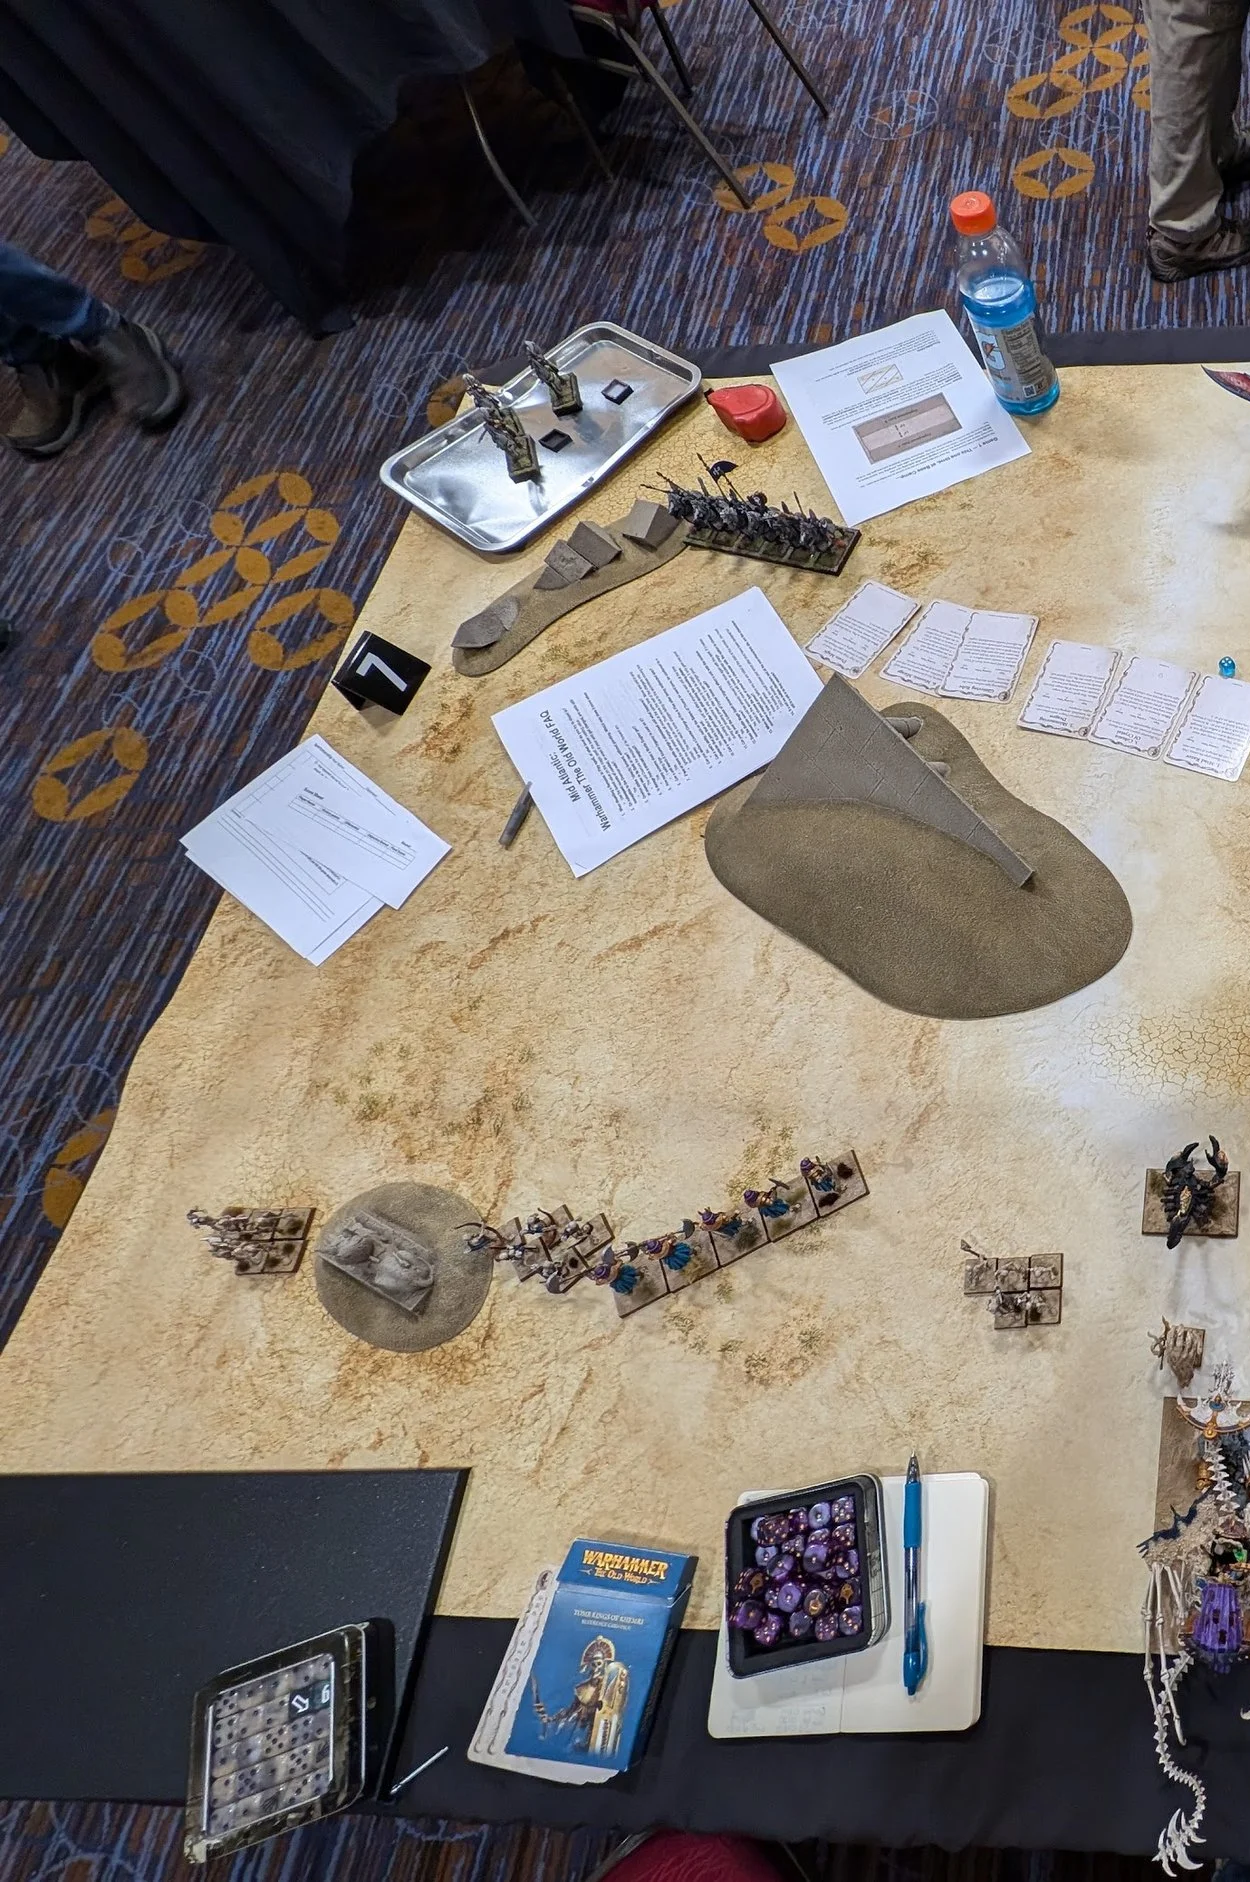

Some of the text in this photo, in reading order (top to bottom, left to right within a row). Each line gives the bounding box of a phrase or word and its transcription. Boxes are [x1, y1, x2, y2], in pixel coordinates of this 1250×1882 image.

[356, 652, 407, 691] 7
[538, 708, 613, 831] Warhammer The Old World FAQ
[546, 750, 581, 802] Mid Atlantic:
[581, 1549, 669, 1579] WARHAMMER
[607, 1569, 622, 1579] OLD
[623, 1571, 647, 1585] WORLD
[591, 1611, 609, 1620] KINGS
